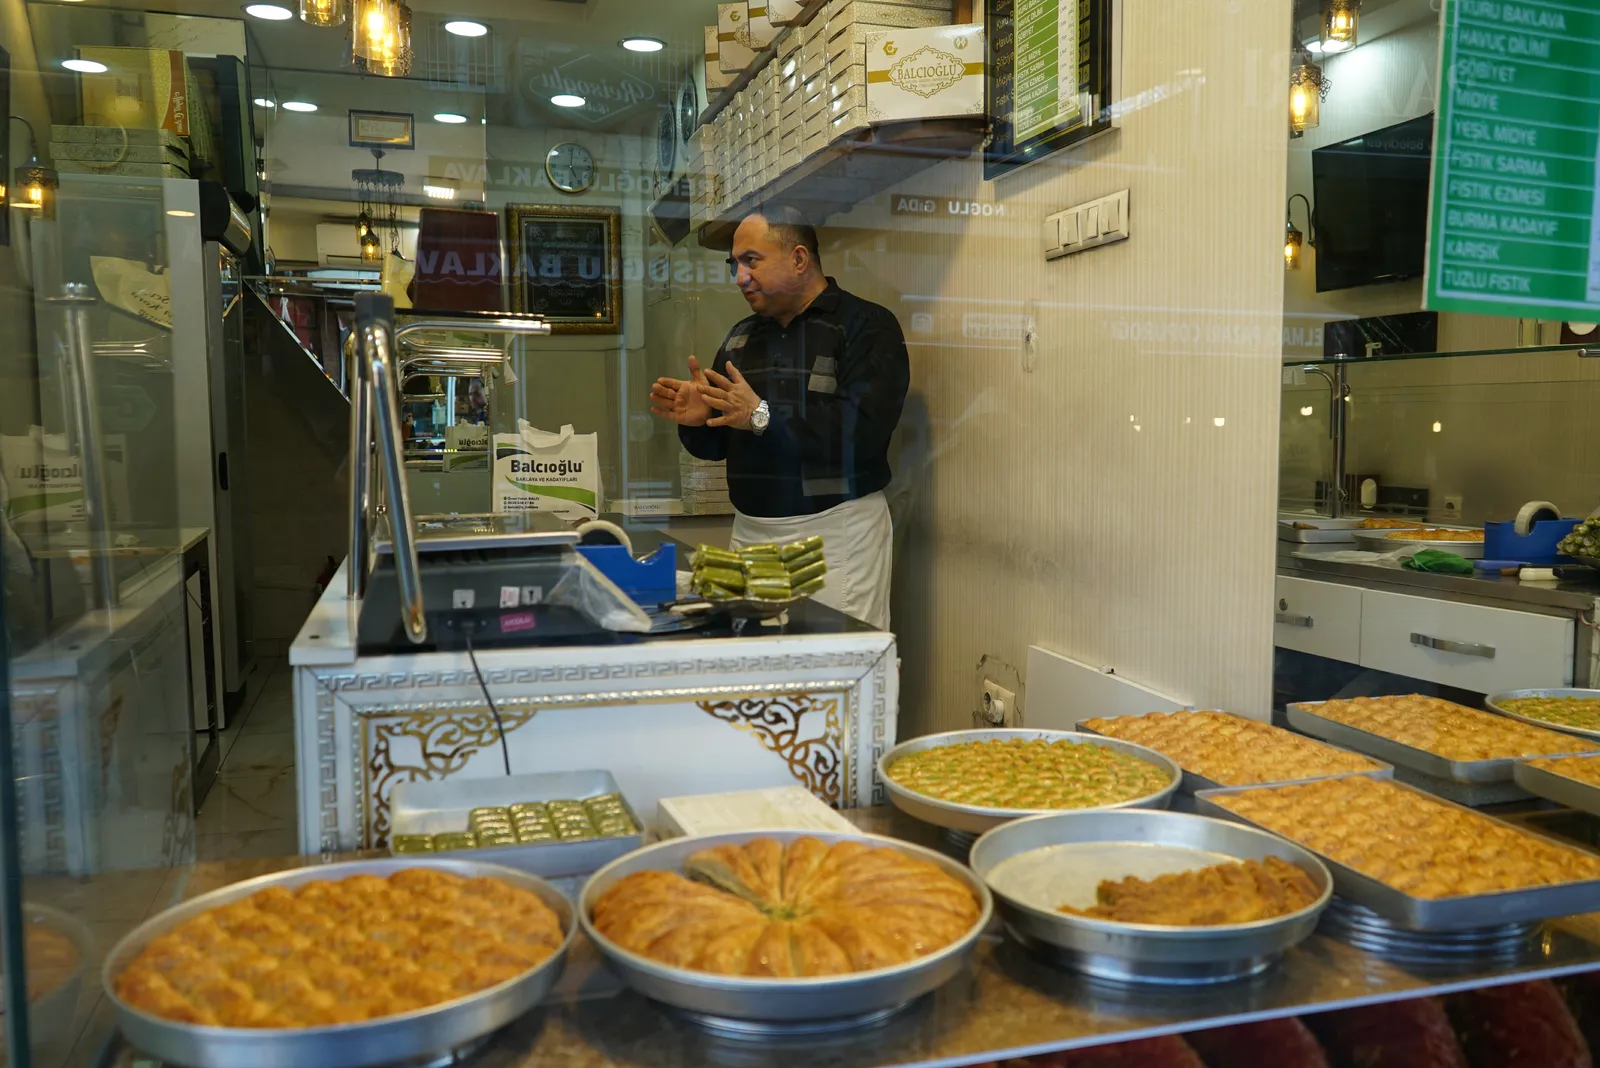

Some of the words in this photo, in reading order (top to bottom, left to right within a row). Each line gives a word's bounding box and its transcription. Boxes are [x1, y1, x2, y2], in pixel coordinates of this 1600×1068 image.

[1503, 5, 1566, 30] BAKLAVA
[897, 62, 957, 80] BALCIOĞLU
[1497, 156, 1548, 177] SARMA
[1448, 209, 1498, 229] BURMA
[1500, 216, 1559, 236] KADAYIF
[1444, 270, 1487, 289] TUZLU
[511, 459, 582, 476] Balcıoğlu
